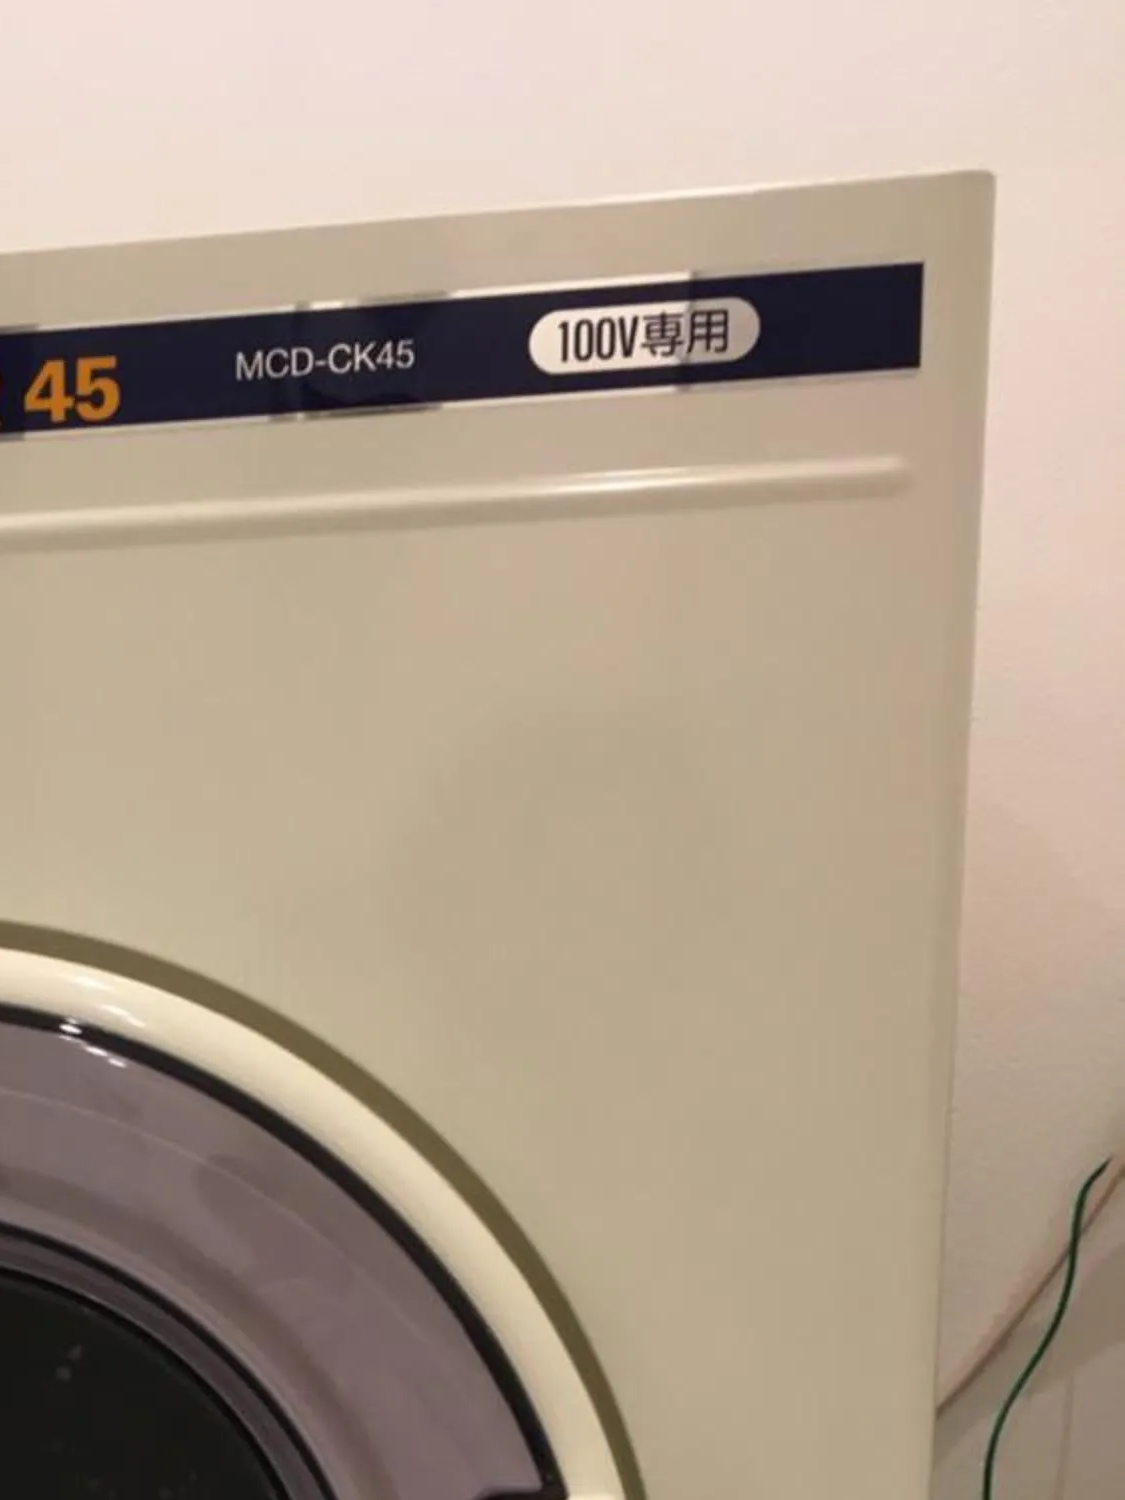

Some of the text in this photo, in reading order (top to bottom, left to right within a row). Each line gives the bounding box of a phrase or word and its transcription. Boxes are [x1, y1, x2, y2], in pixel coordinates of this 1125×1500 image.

[235, 339, 416, 381] MCD-CK45
[556, 308, 731, 364] 100V専用
[24, 355, 122, 424] 45
